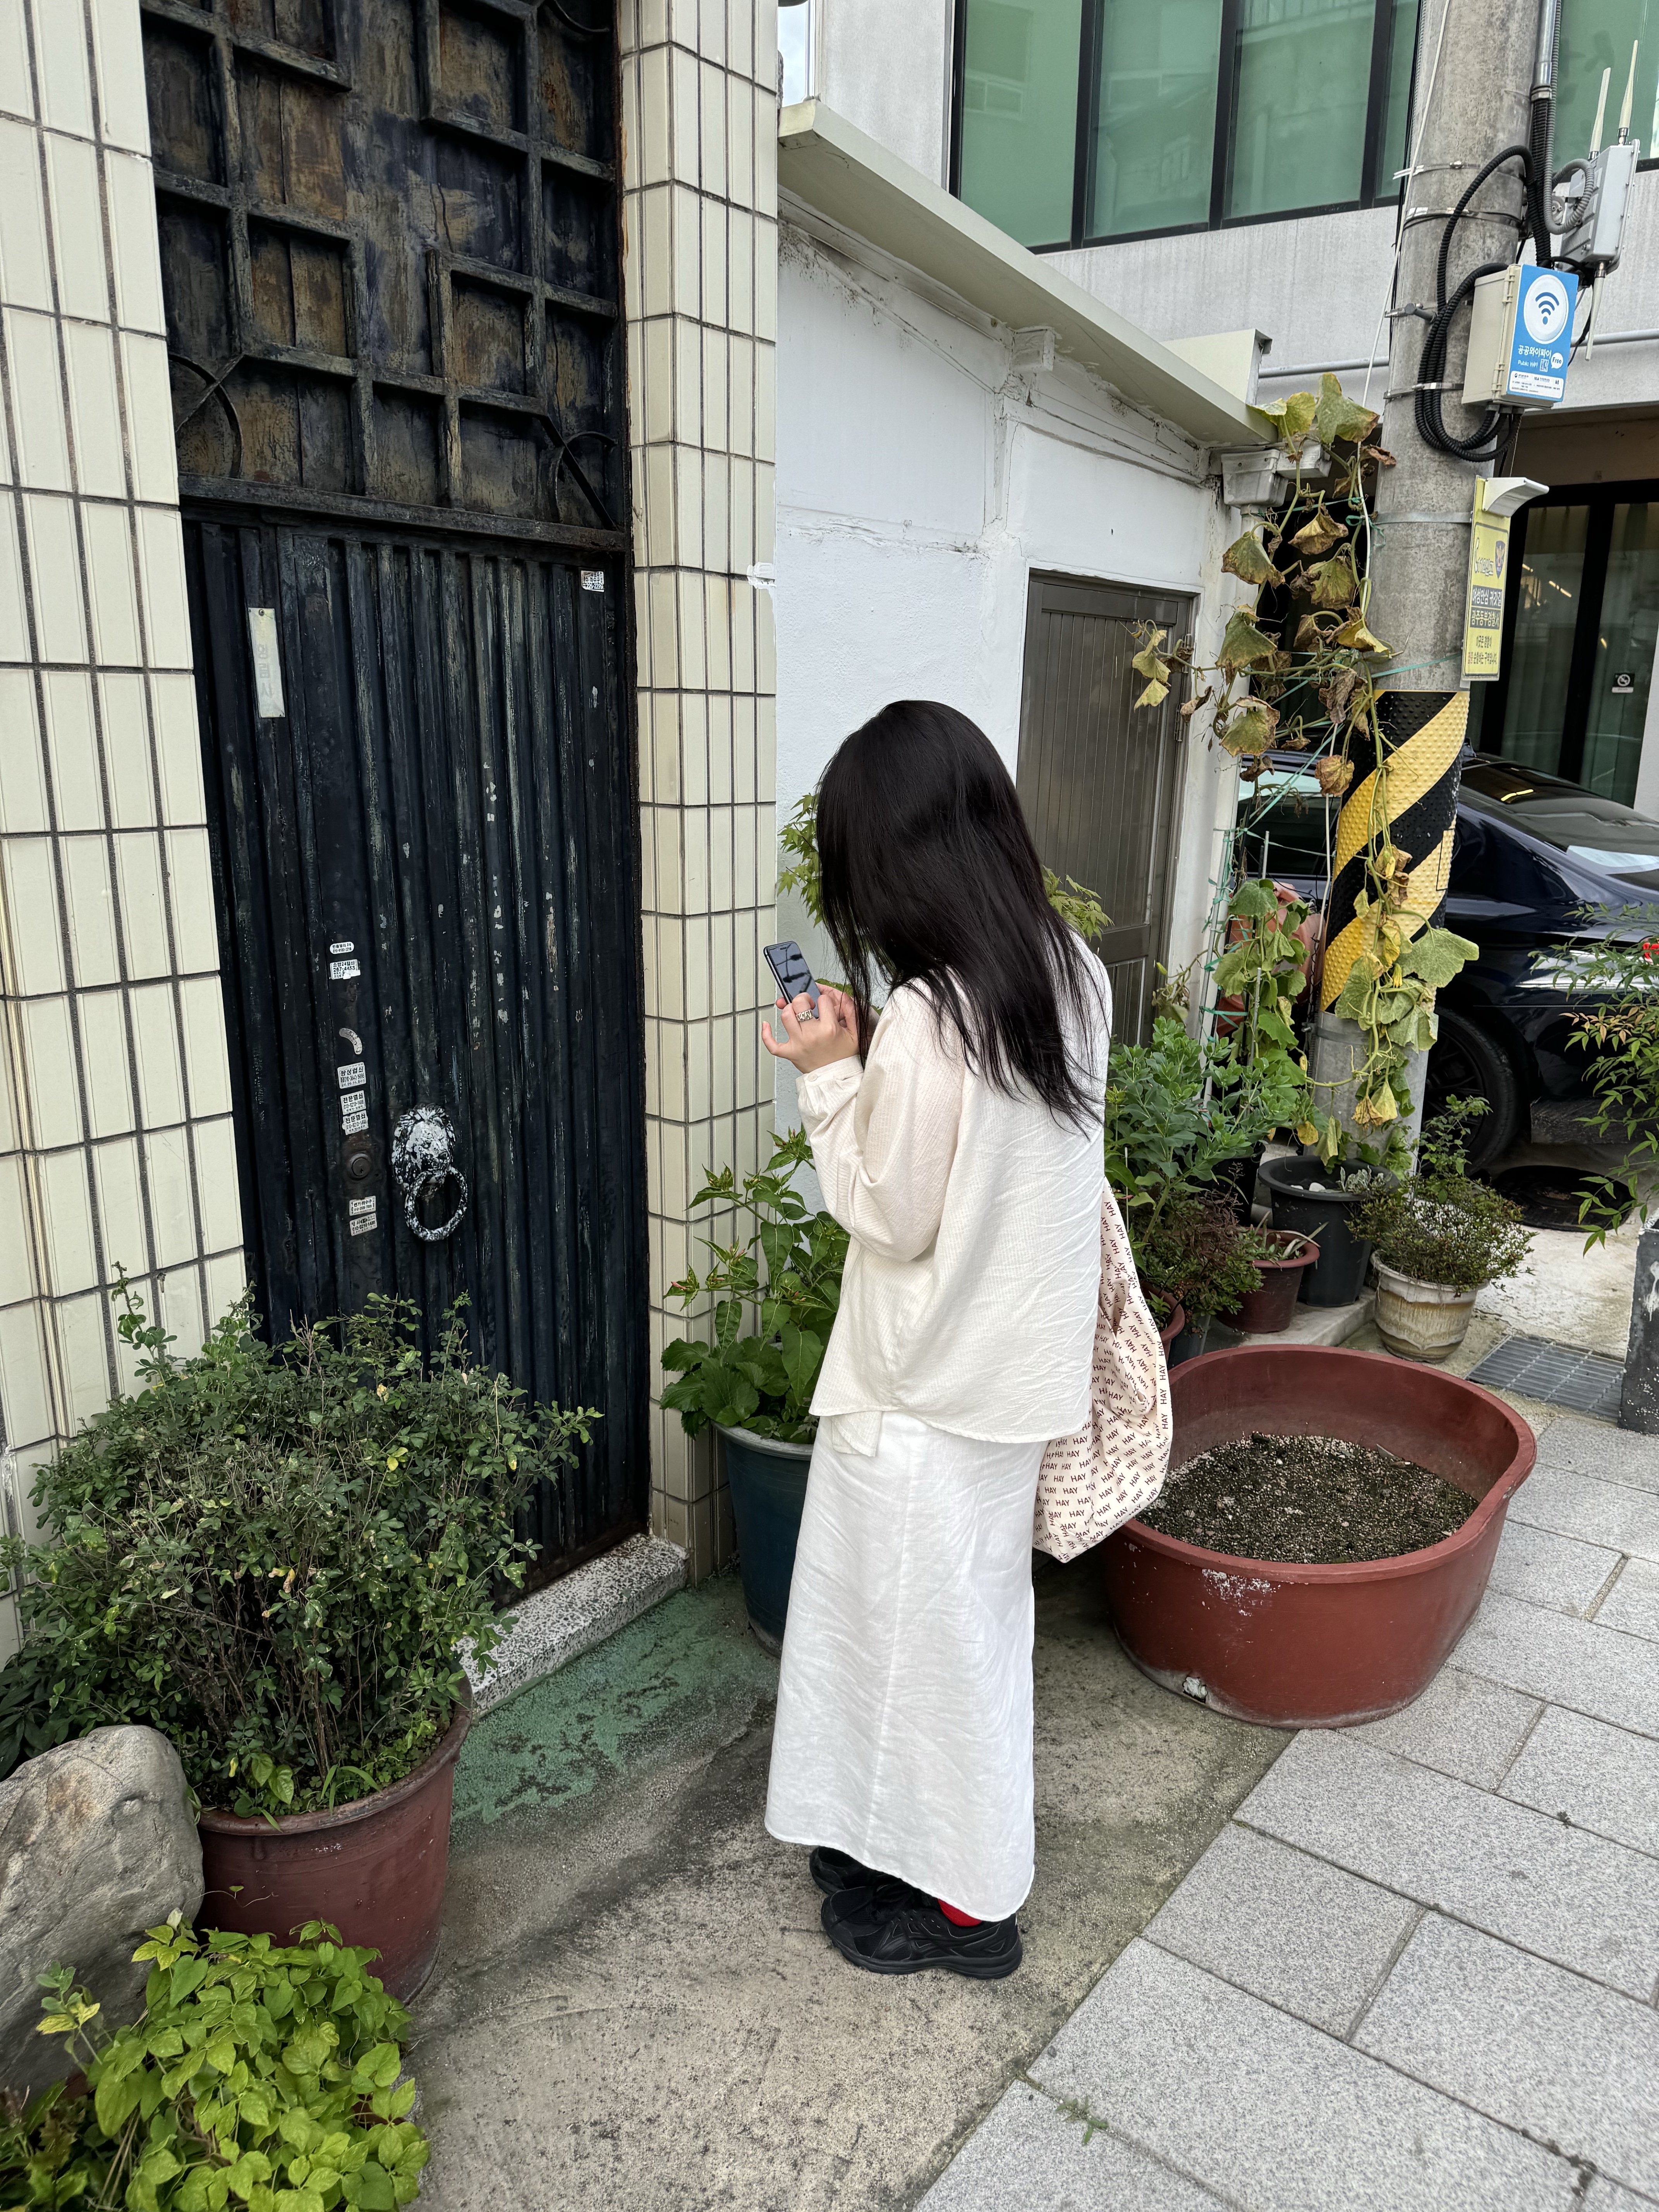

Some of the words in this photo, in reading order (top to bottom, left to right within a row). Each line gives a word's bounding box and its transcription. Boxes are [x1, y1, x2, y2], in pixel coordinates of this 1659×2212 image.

[1472, 587, 1489, 605] 여성안심
[1489, 590, 1501, 607] 귀갓길
[1472, 610, 1500, 627] 광주동부경찰서
[1104, 1202, 1116, 1216] HAY
[1101, 1217, 1111, 1231] HAY
[1115, 1224, 1125, 1239] HAY
[1109, 1240, 1120, 1254] HAY
[1107, 1278, 1115, 1293] HAY
[1103, 1293, 1113, 1307] HAY
[1133, 1311, 1144, 1324] HAY
[1128, 1325, 1141, 1338] HAY
[1124, 1339, 1137, 1353] HAY
[1140, 1344, 1153, 1357] HAY
[1137, 1358, 1149, 1373] HAY
[1109, 1391, 1123, 1401] HAY
[1137, 1415, 1149, 1429] HAY
[1073, 1436, 1087, 1445] HAY
[1106, 1428, 1119, 1441] HAY
[1122, 1432, 1136, 1445] HAY
[1106, 1444, 1119, 1456] HAY
[1123, 1448, 1137, 1457] HAY
[1140, 1450, 1154, 1460] HAY
[1111, 1456, 1121, 1471] HAY
[1126, 1458, 1139, 1470] HAY
[1142, 1462, 1156, 1472] HAY
[1071, 1473, 1086, 1482] HAY
[1101, 1469, 1115, 1483] HAY
[1129, 1471, 1140, 1487] HAY
[1145, 1475, 1157, 1486] HAY
[1099, 1486, 1113, 1499] HAY
[1116, 1489, 1128, 1503] HAY
[1131, 1488, 1144, 1503] HAY
[1146, 1487, 1158, 1501] HAY
[1069, 1510, 1085, 1518] HAY
[1097, 1503, 1111, 1516] HAY
[1114, 1506, 1128, 1520] HAY
[1053, 1533, 1063, 1547] HAY
